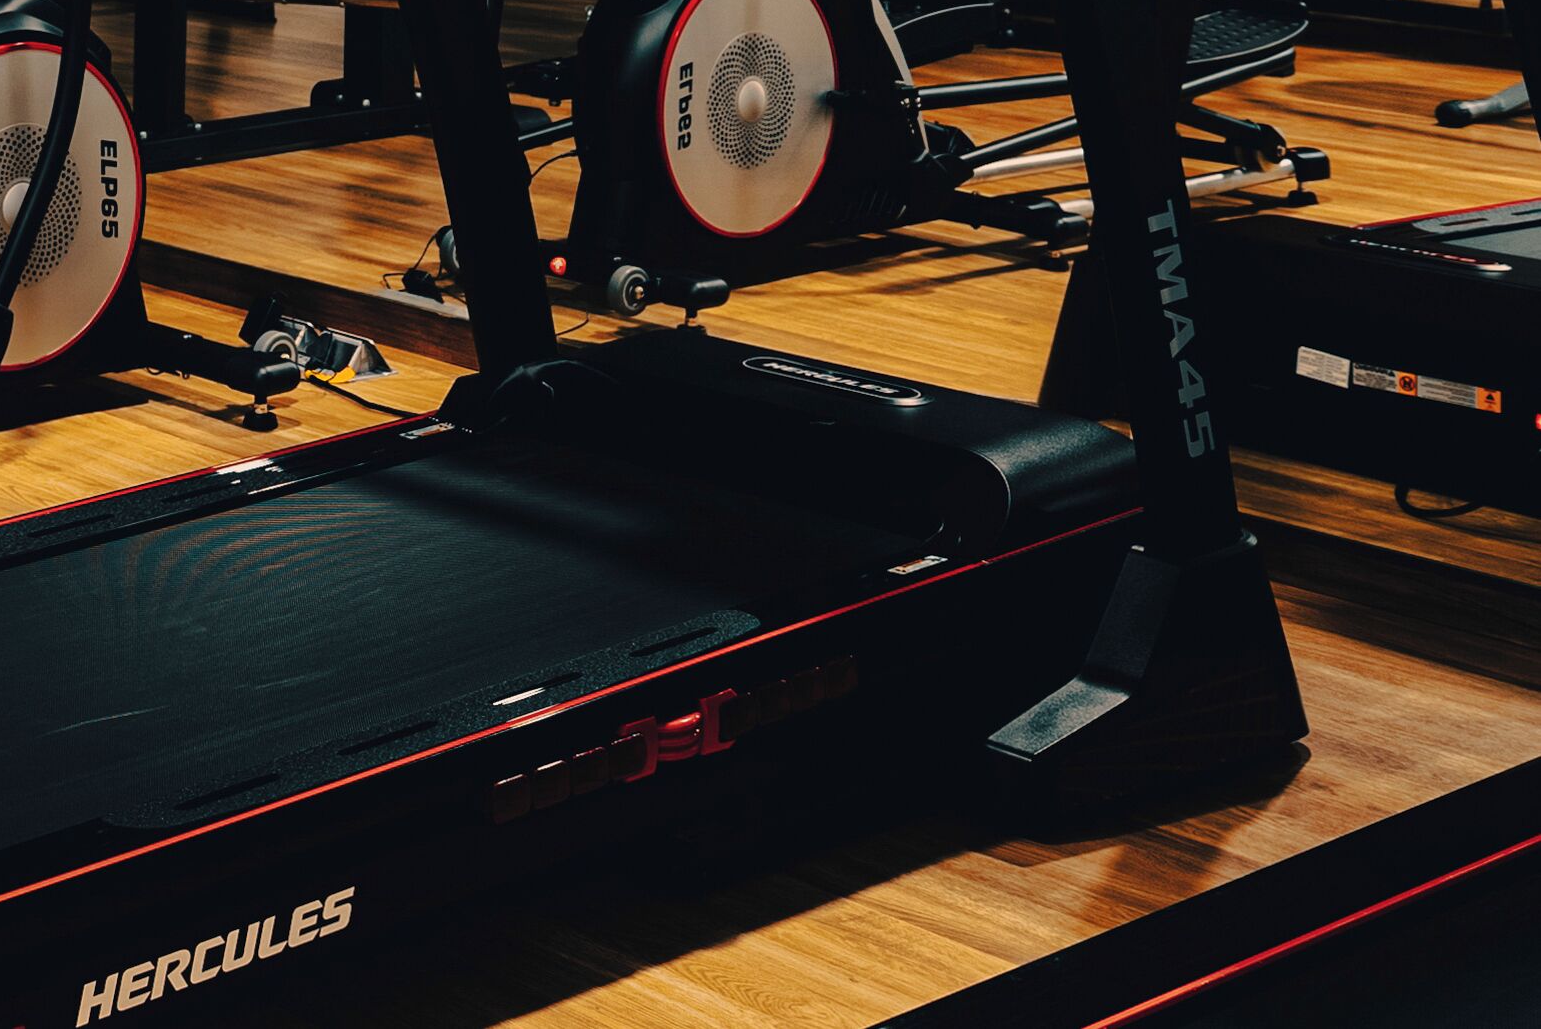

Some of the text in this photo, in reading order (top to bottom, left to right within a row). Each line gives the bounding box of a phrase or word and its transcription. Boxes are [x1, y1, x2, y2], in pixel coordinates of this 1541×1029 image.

[100, 139, 119, 239] ELP65
[1146, 197, 1216, 459] TMA45
[75, 885, 356, 1029] HERCULES
